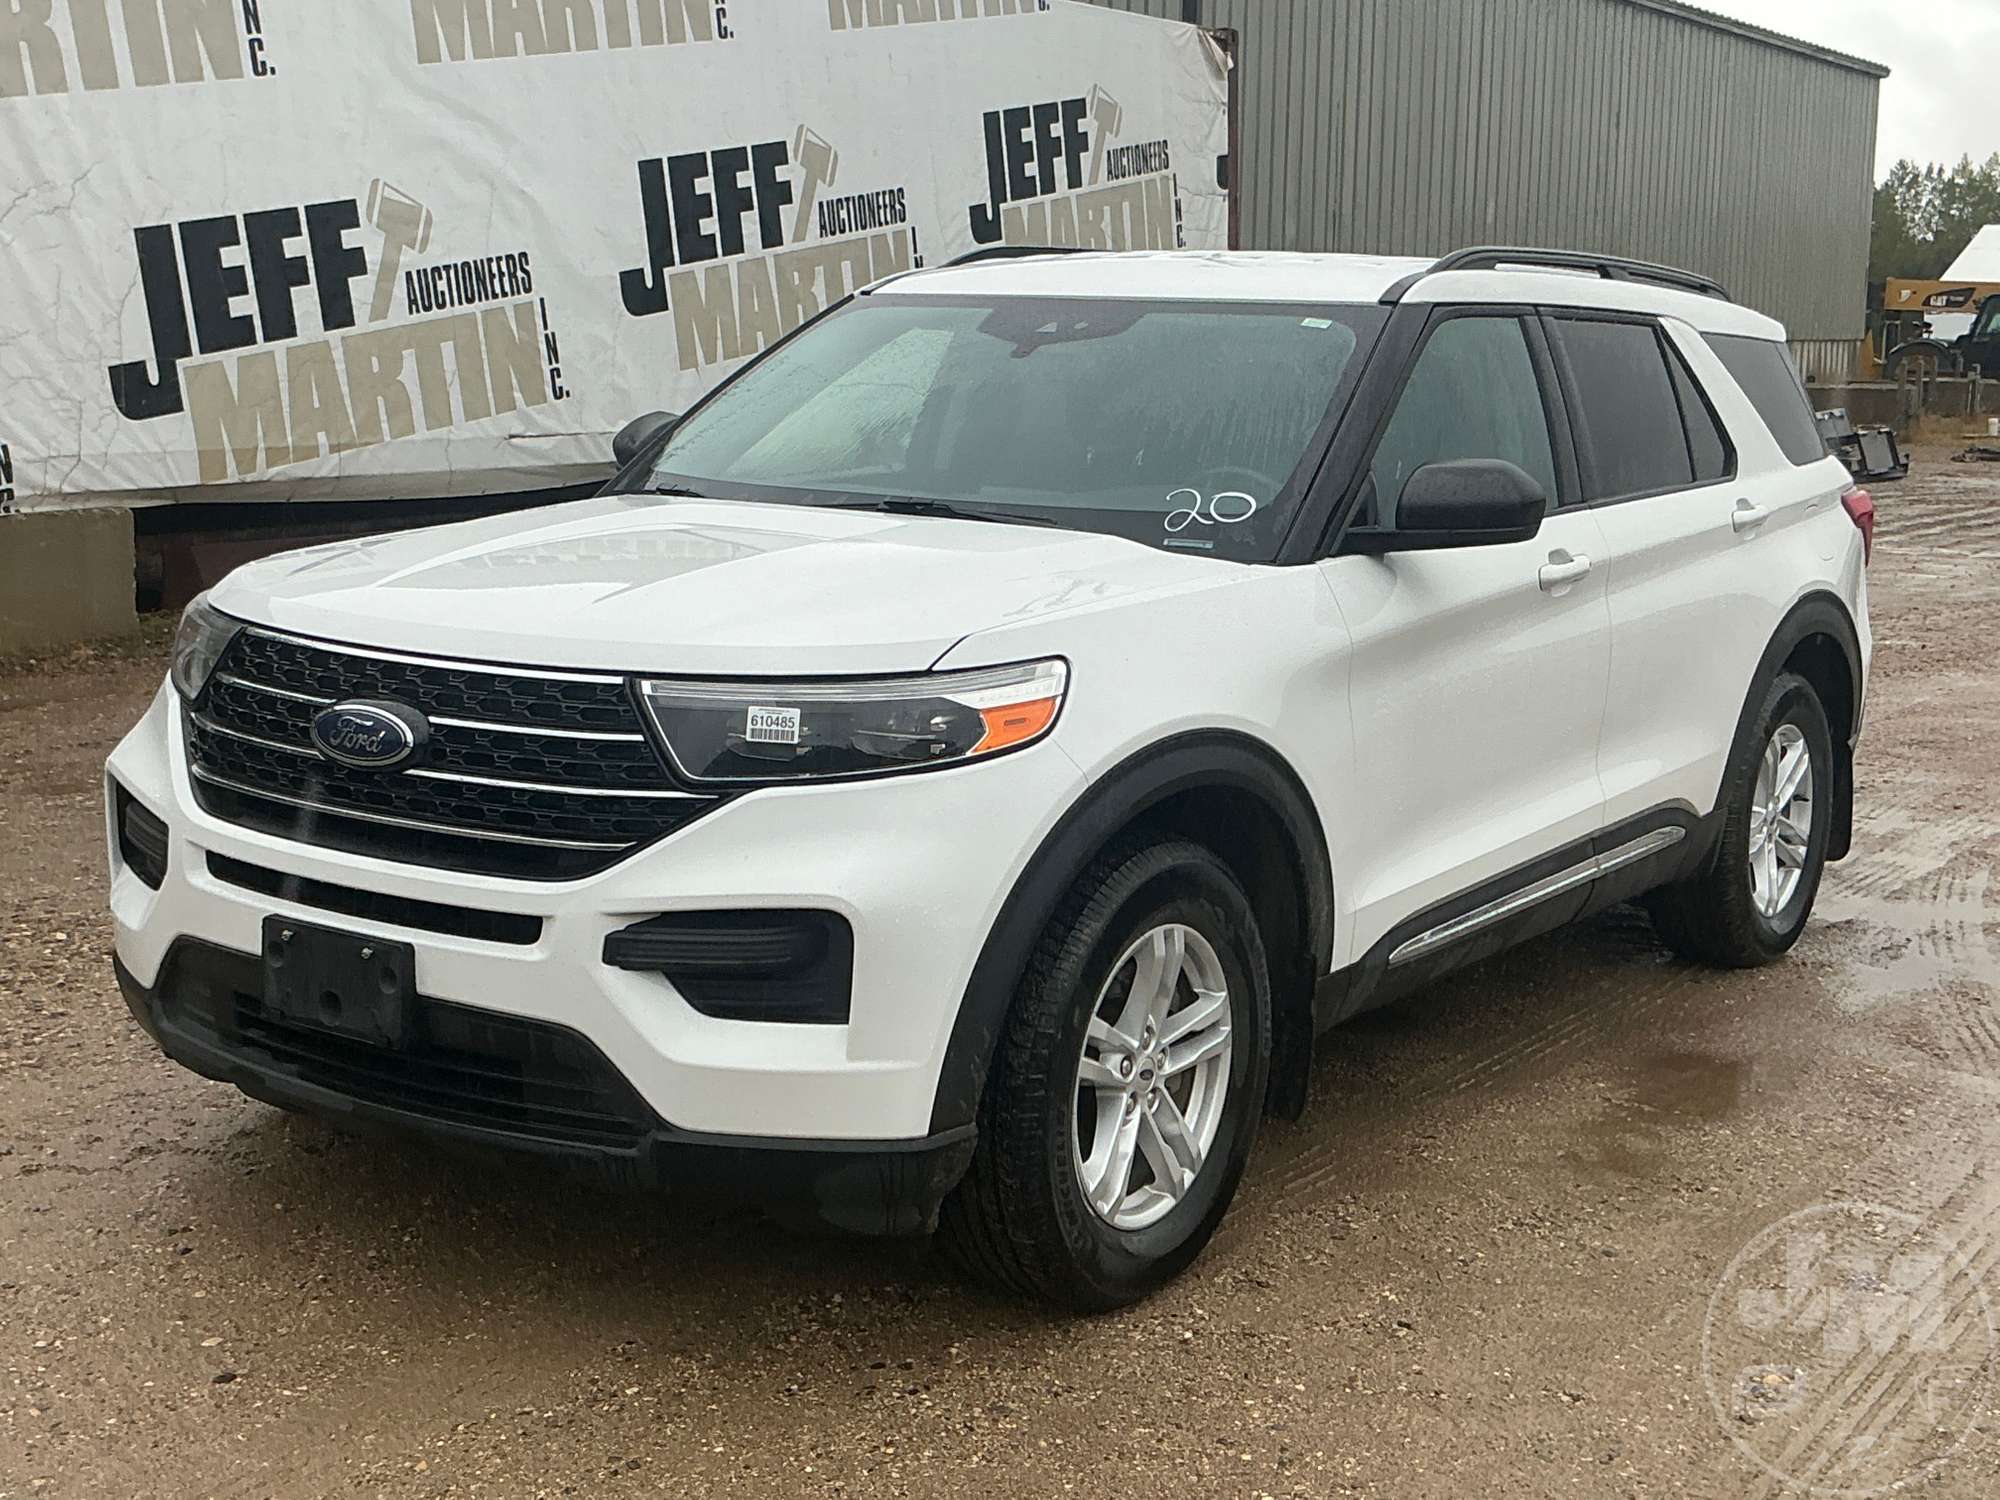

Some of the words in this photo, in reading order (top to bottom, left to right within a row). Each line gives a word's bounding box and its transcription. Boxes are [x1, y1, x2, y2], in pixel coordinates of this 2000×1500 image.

[969, 97, 1090, 245] JEFF
[1106, 140, 1170, 182] AUCTIONEERS
[619, 140, 793, 317] JEFF
[818, 187, 907, 239] AUCTIONEERS
[107, 198, 368, 422] JEFF
[405, 252, 533, 316] AUCTIONEERS
[1930, 295, 1948, 306] CAT
[181, 301, 548, 485] MARTIN
[1164, 488, 1257, 532] 20
[329, 716, 387, 753] Ford
[751, 715, 796, 729] 610485
